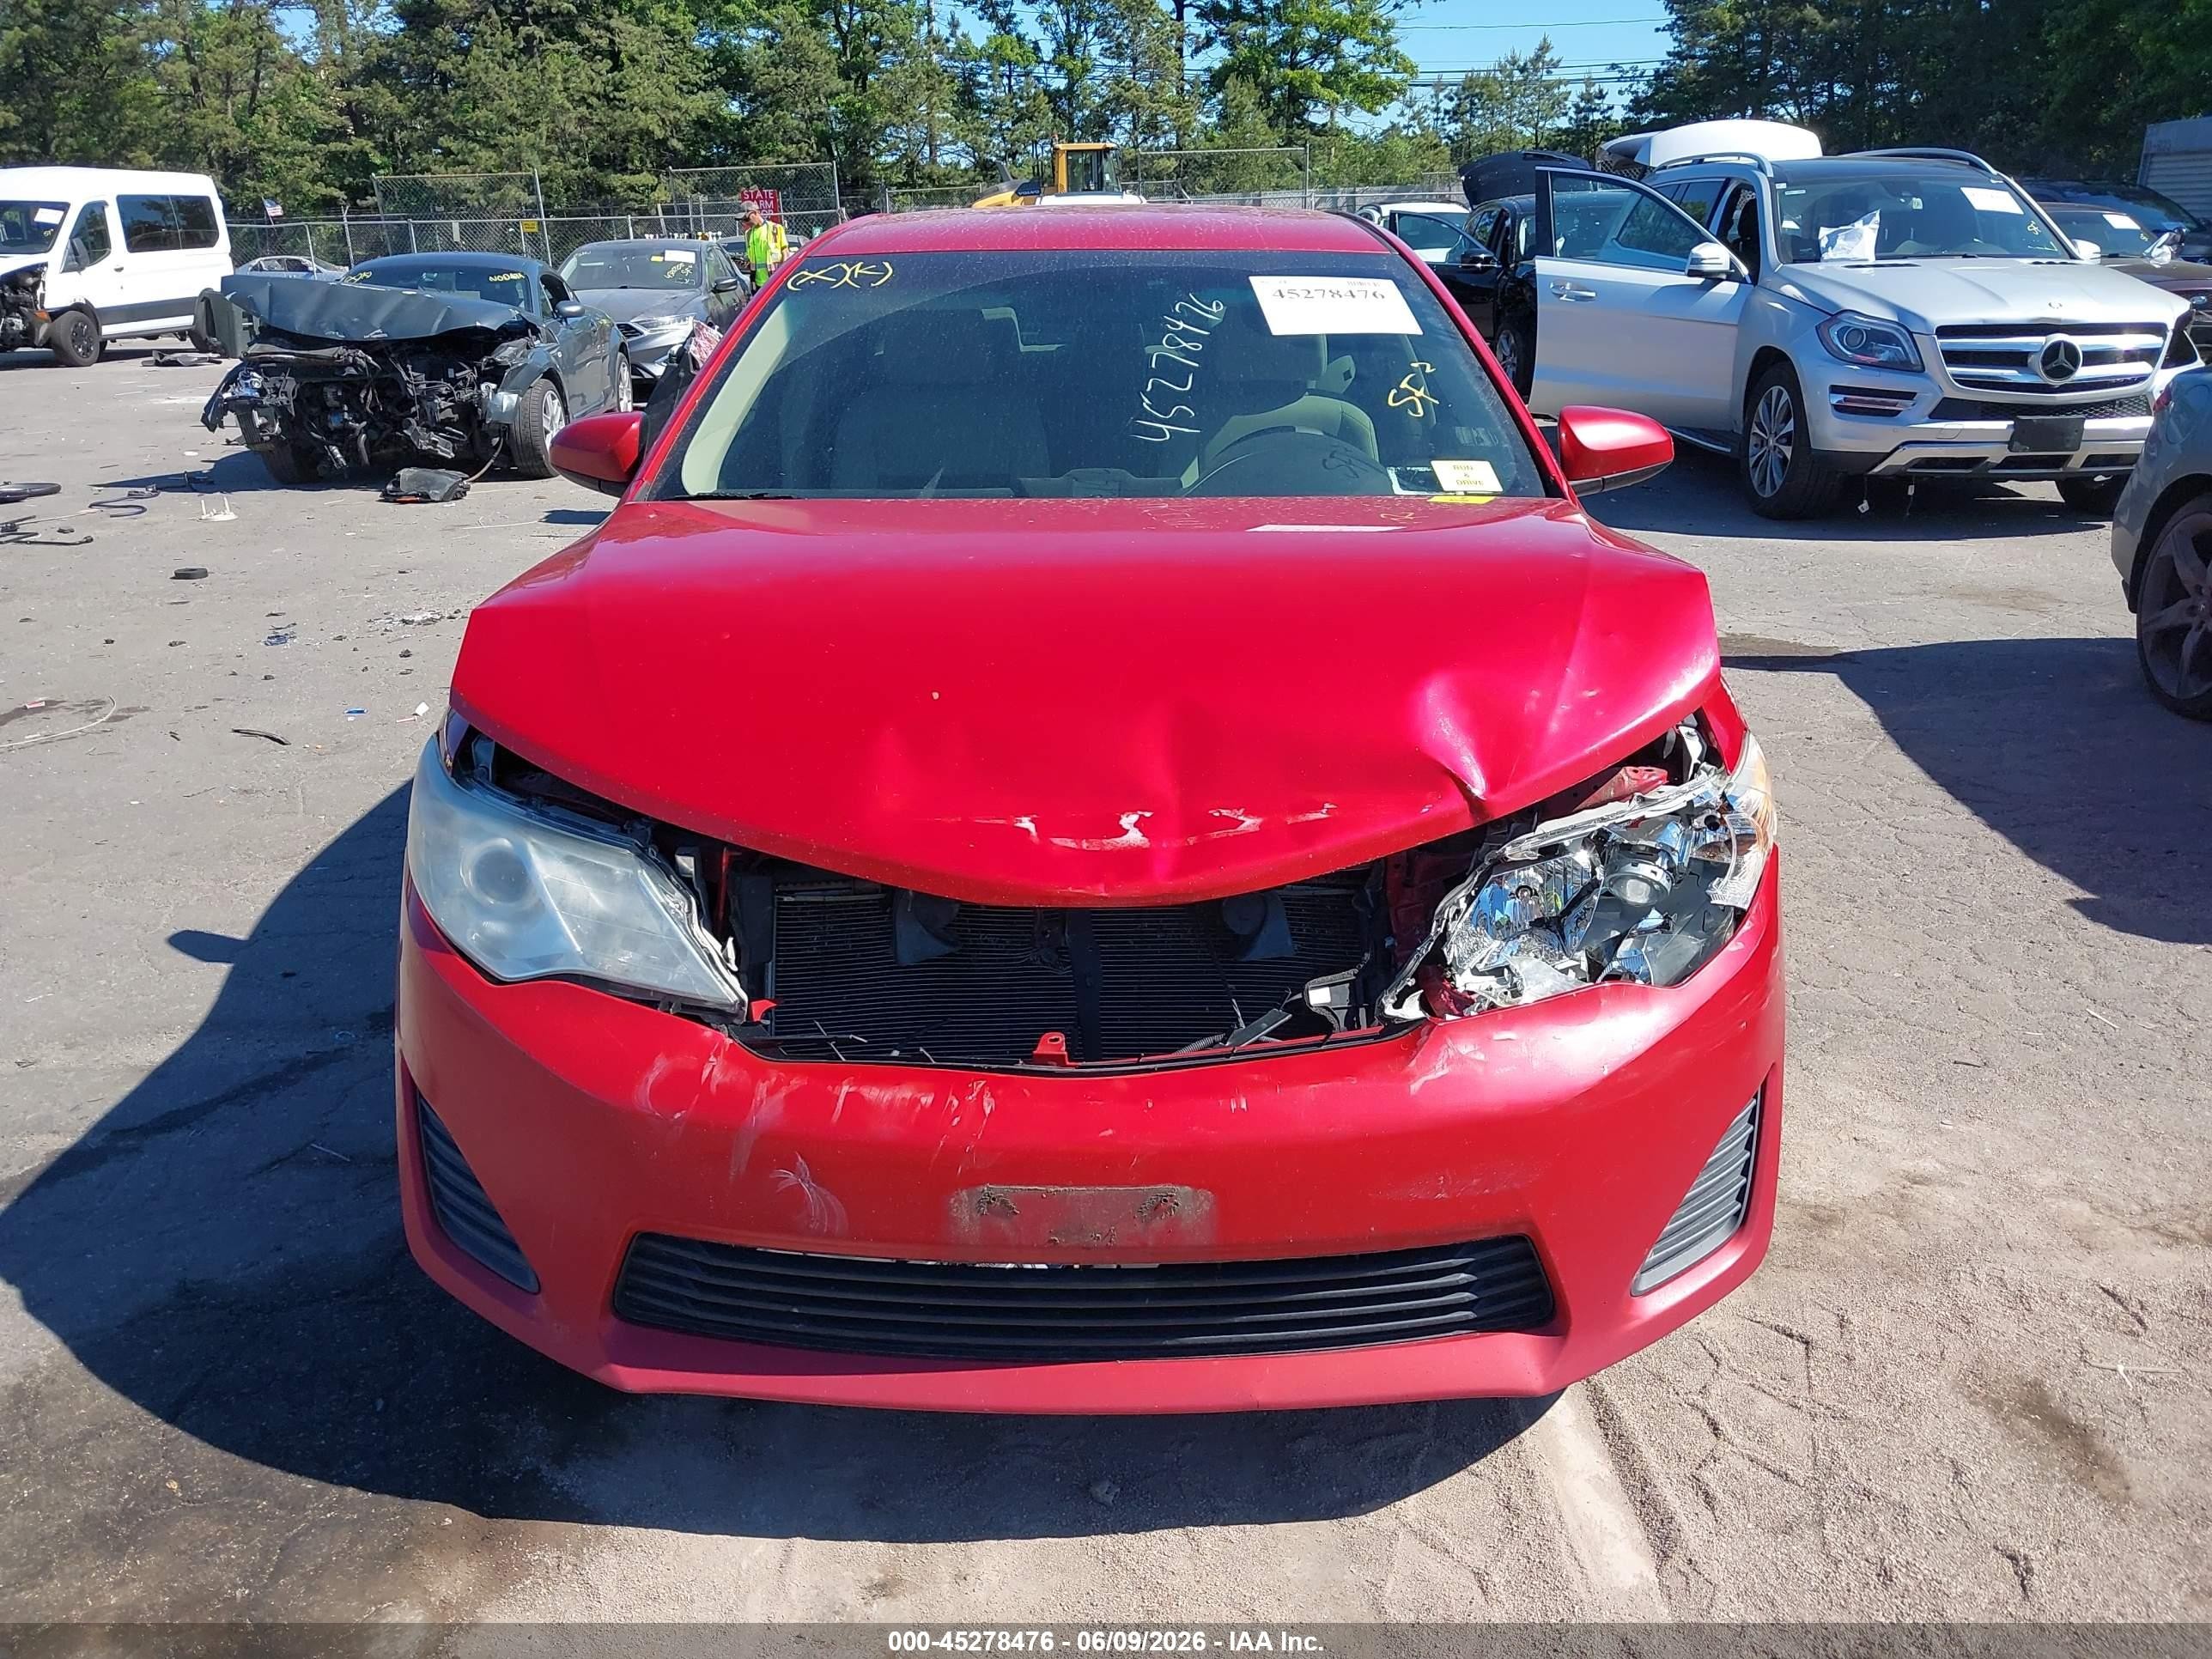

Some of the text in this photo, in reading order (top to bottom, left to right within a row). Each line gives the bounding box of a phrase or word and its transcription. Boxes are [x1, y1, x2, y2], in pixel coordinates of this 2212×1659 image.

[743, 189, 775, 199] STATE
[1272, 289, 1385, 300] 45278476
[1128, 290, 1224, 441] 45278476
